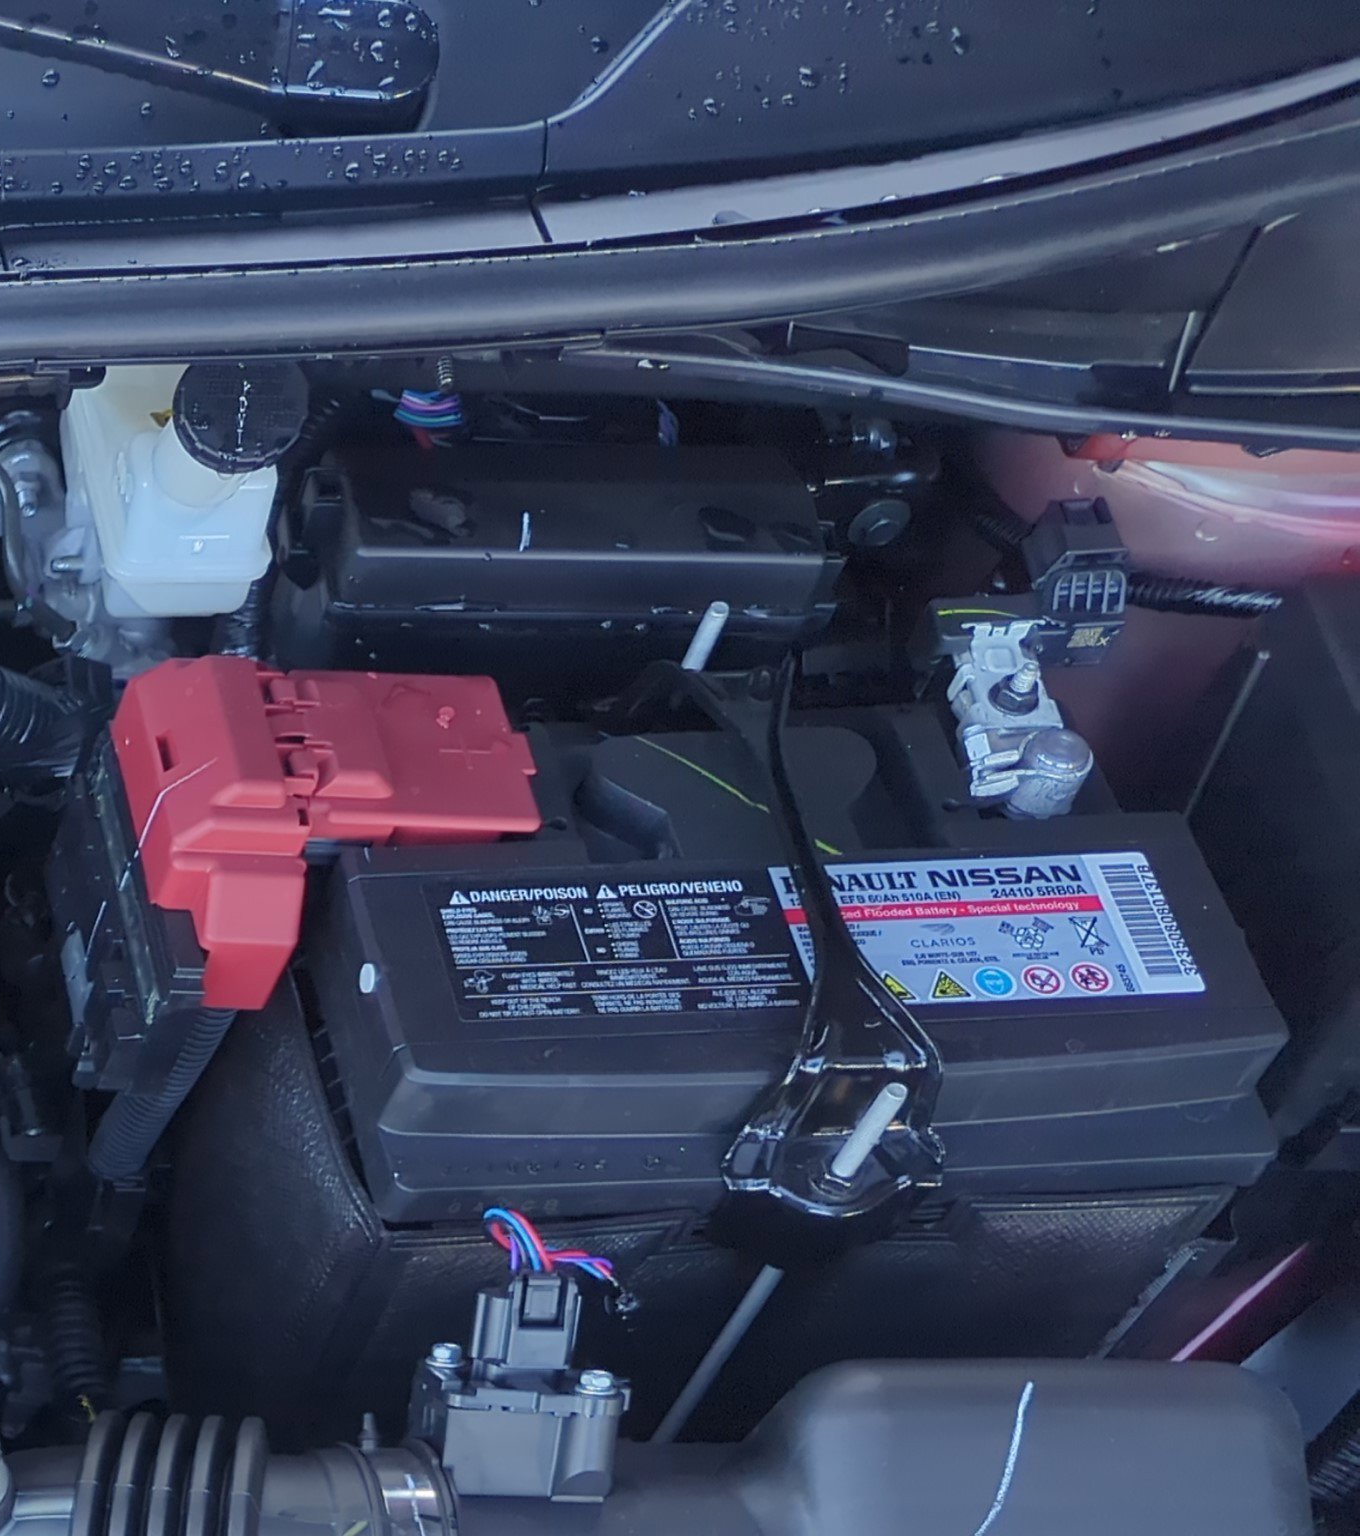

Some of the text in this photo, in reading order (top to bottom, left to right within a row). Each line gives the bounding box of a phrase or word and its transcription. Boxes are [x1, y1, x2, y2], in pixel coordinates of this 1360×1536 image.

[928, 864, 1082, 888] NISSAN
[470, 886, 588, 902] DANGER/POISON
[618, 880, 743, 897] PELIGRO/VENENO
[991, 886, 1034, 899] 24410
[840, 895, 865, 904] EFB
[934, 890, 962, 902] (EN)
[864, 907, 912, 917] Flooded
[915, 906, 958, 917] Battery
[968, 904, 1011, 915] Special
[1013, 900, 1080, 913] technology
[910, 936, 976, 949] CLARIOS
